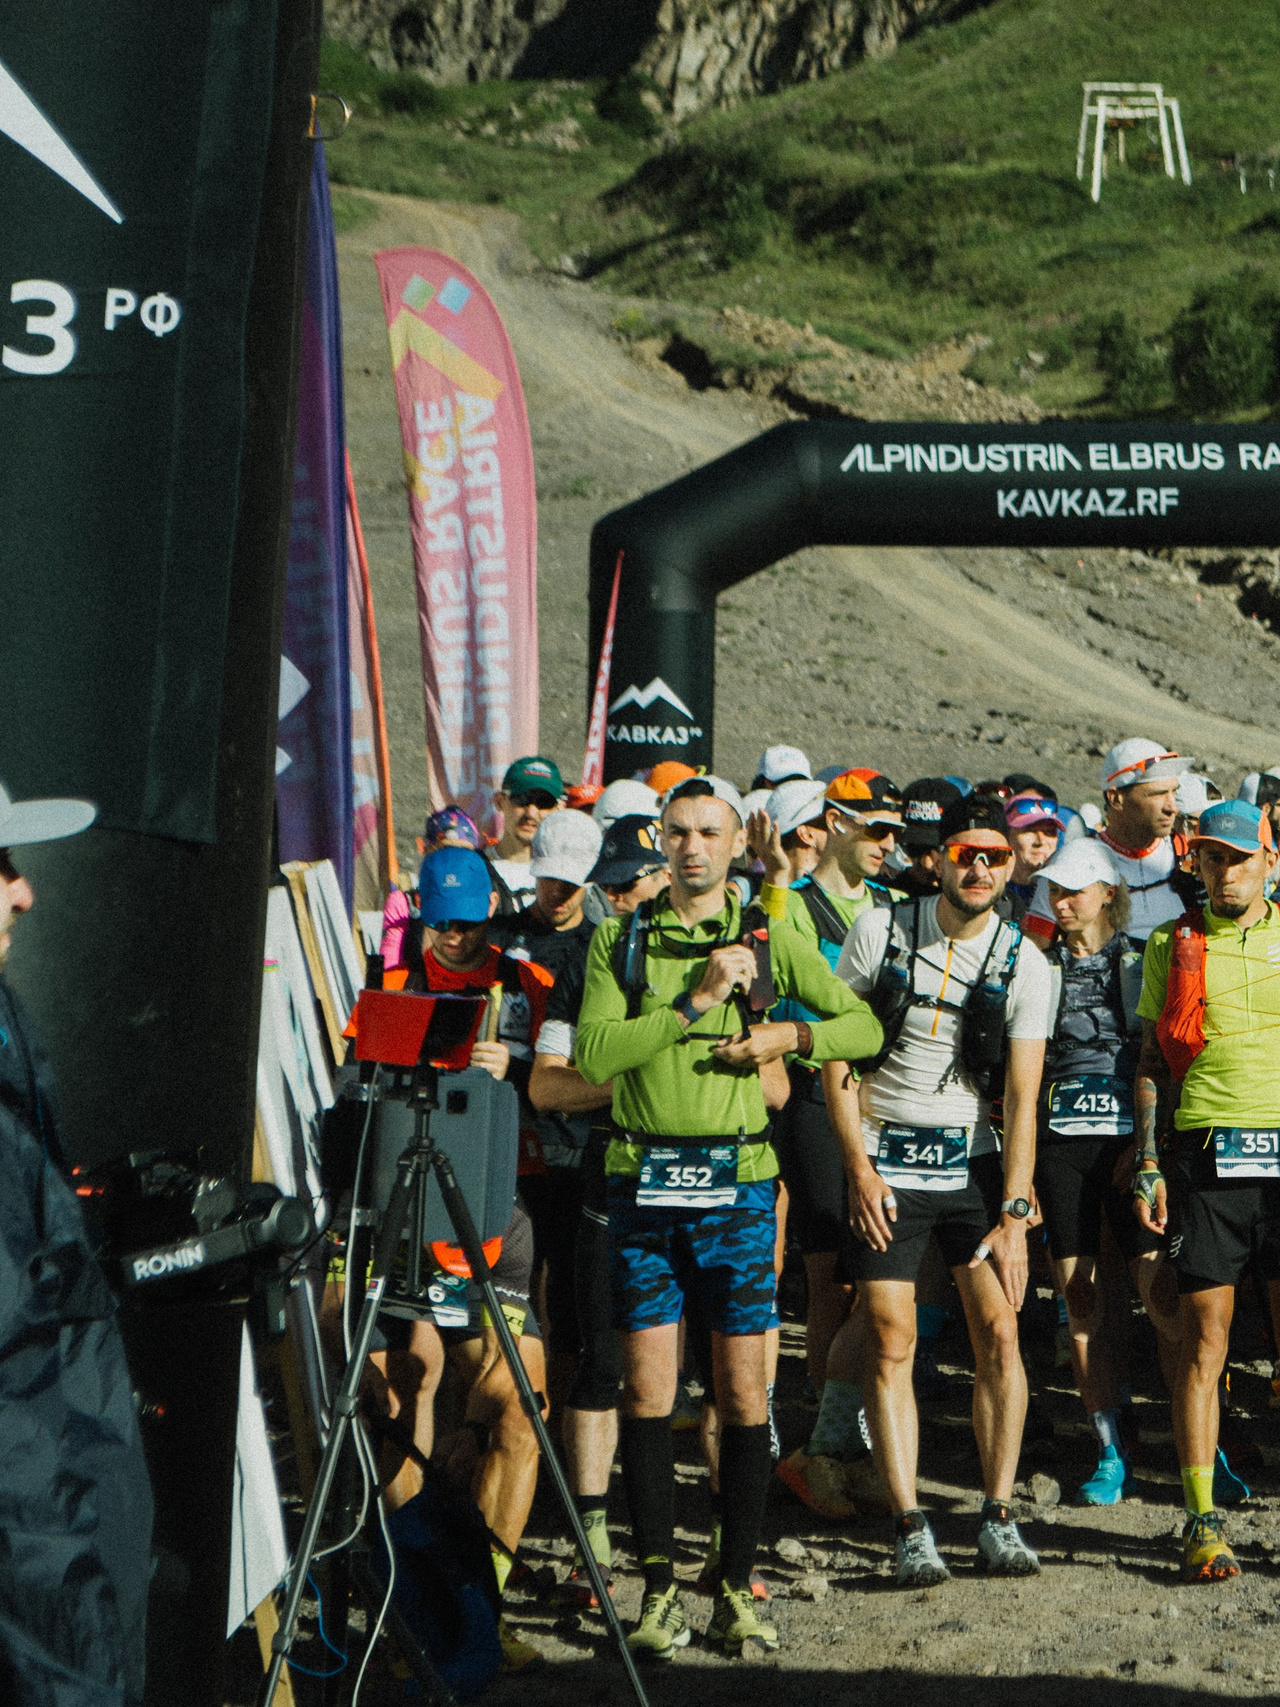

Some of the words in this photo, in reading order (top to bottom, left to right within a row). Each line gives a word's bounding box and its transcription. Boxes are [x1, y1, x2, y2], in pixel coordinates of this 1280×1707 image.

[104, 287, 181, 337] РФ
[841, 444, 1082, 472] ALPINDUSTRIA
[1089, 443, 1224, 471] ELBRUS
[997, 488, 1180, 517] KAVKAZ.RF
[1073, 1094, 1110, 1112] 413
[902, 1144, 943, 1165] 341
[1241, 1133, 1279, 1153] 351
[664, 1167, 712, 1188] 352
[132, 1242, 204, 1281] RONIN
